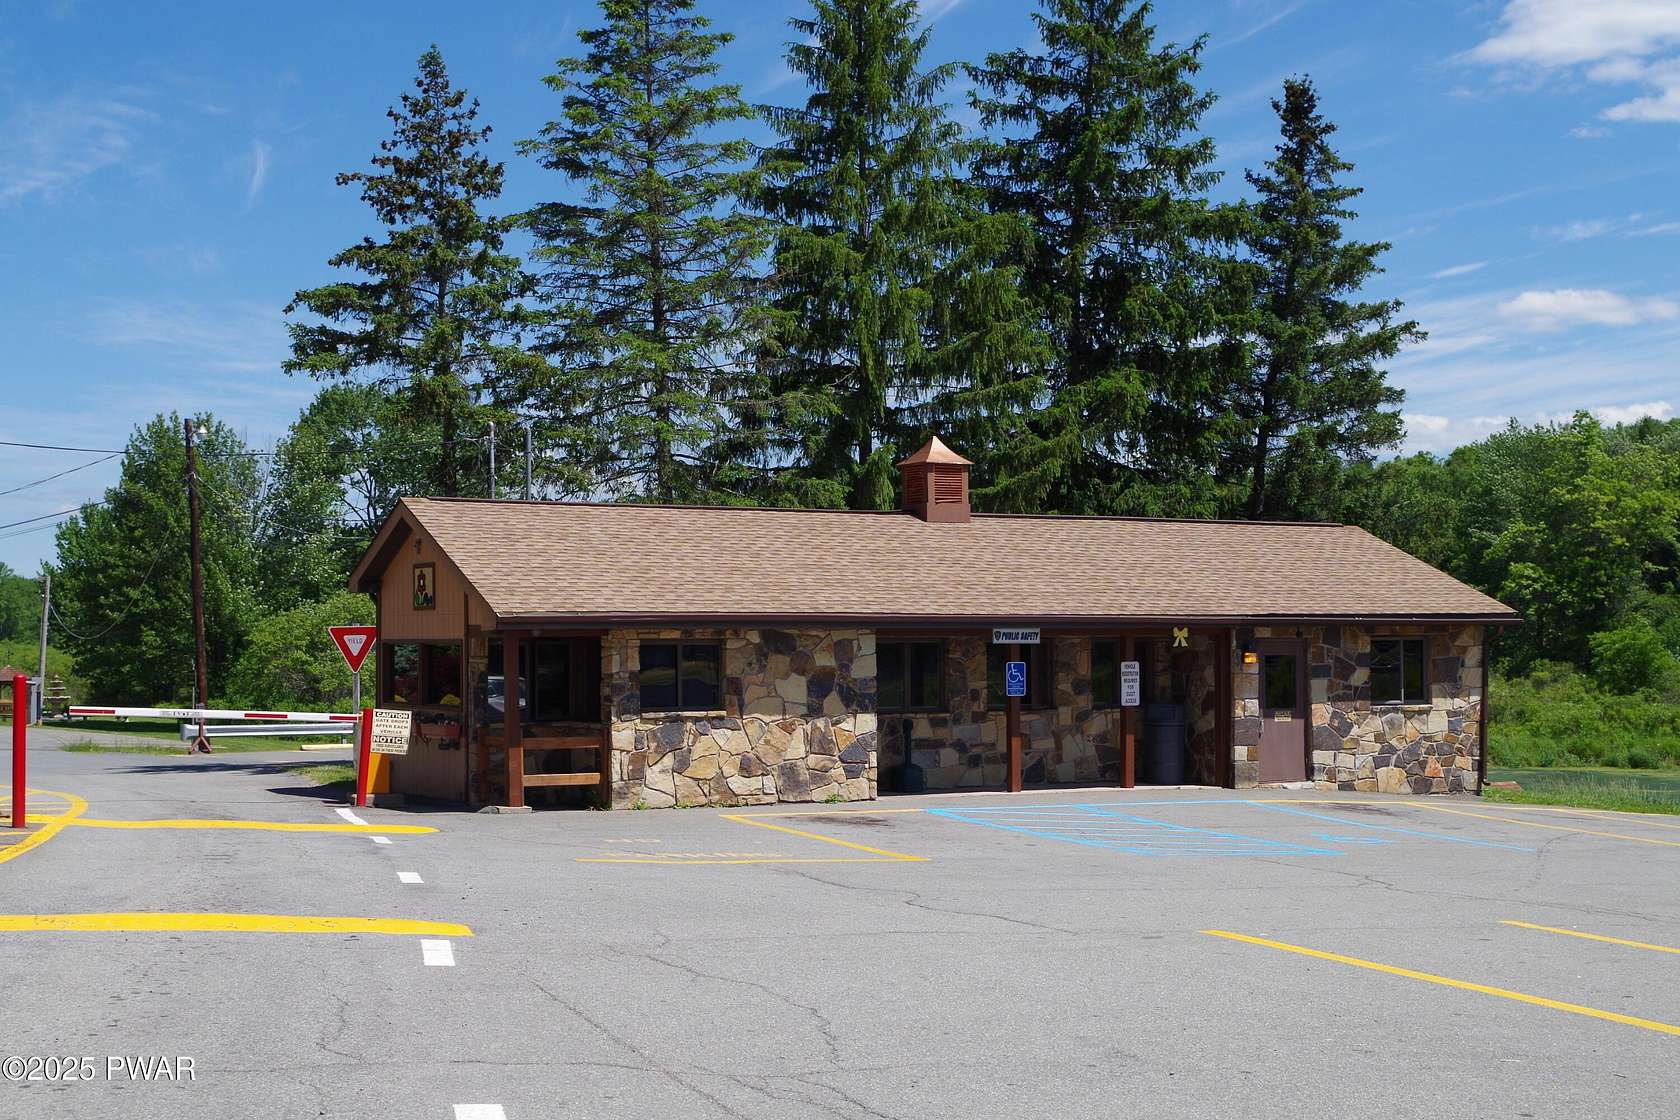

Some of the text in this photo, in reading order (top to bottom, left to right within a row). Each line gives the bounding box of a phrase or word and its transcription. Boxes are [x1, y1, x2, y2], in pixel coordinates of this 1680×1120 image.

[1001, 631, 1039, 641] PUBLIC SAFETY
[376, 712, 409, 720] CAUTION
[373, 736, 408, 744] NOTICE
